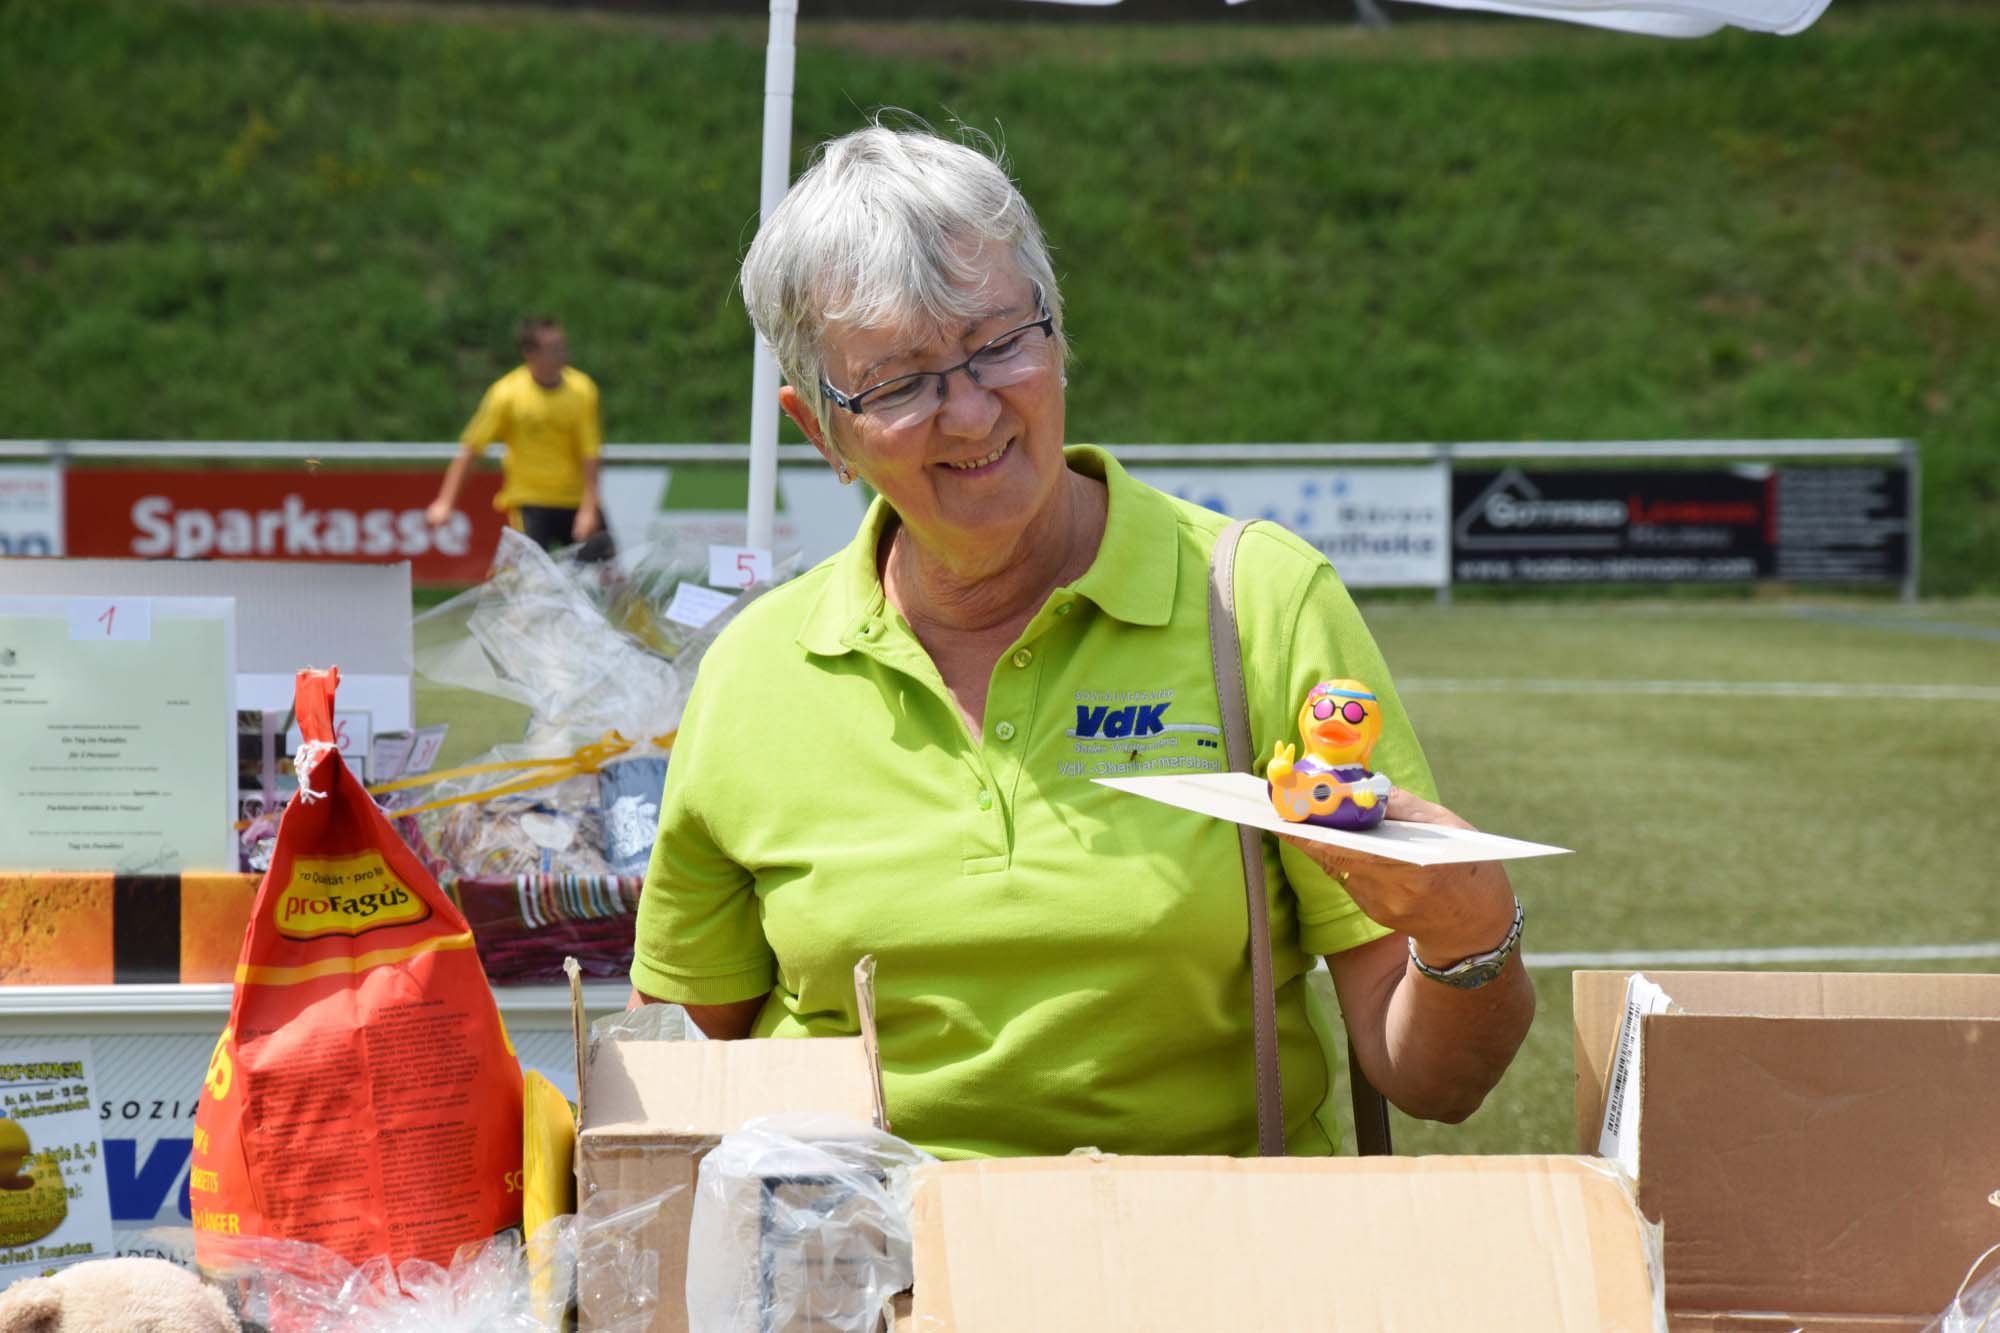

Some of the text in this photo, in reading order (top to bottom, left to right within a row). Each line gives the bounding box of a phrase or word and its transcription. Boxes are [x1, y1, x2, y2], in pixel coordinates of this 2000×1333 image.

[131, 495, 471, 558] Sparkasse
[736, 553, 757, 590] 5
[98, 605, 117, 636] 1
[1076, 702, 1172, 738] VdK
[285, 883, 409, 921] proFagus
[102, 1138, 196, 1220] V
